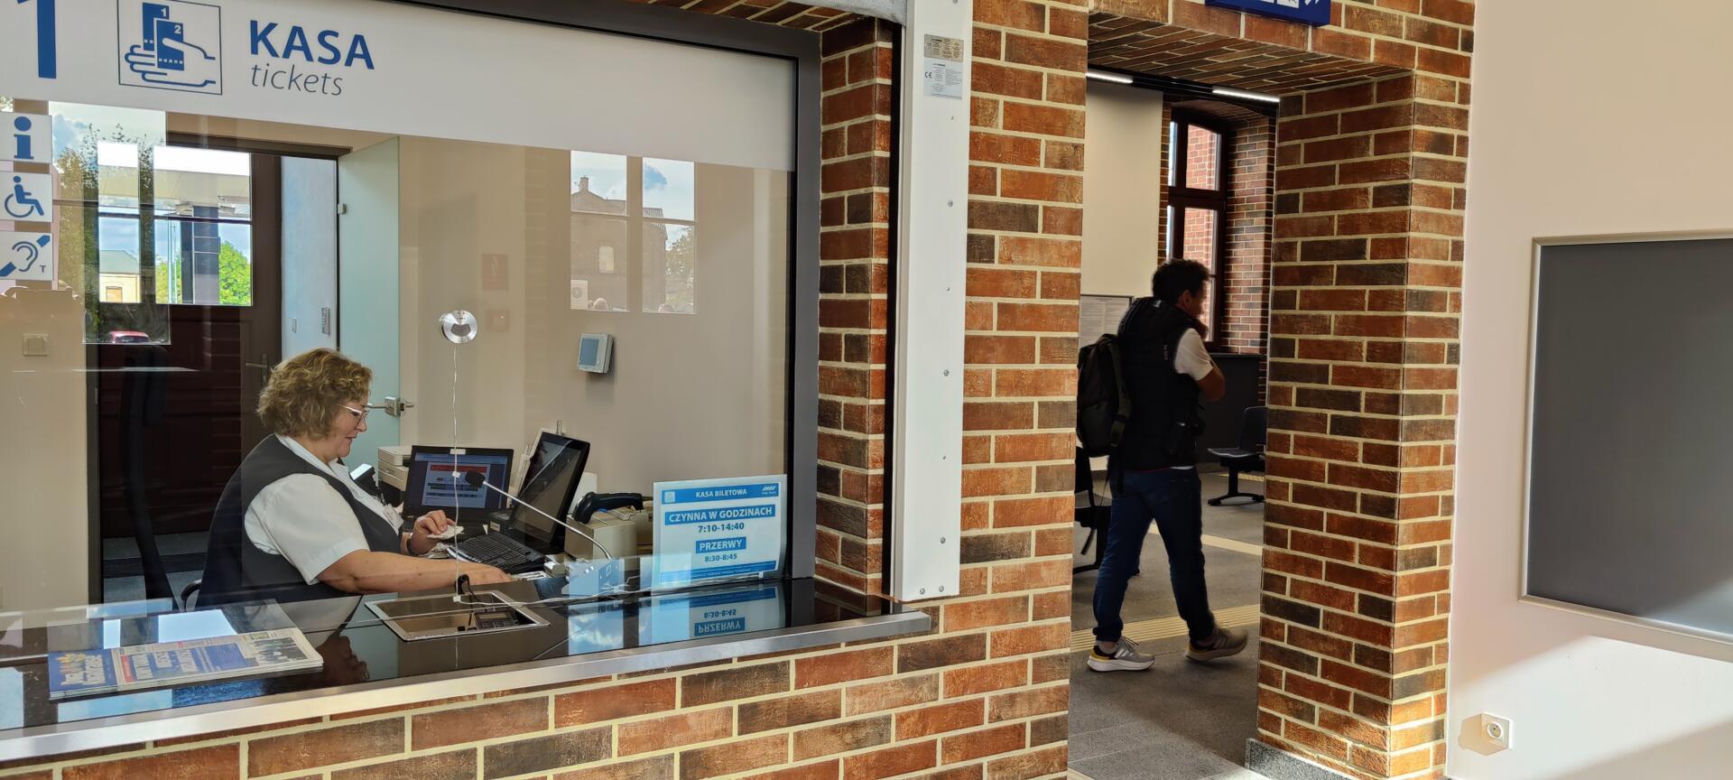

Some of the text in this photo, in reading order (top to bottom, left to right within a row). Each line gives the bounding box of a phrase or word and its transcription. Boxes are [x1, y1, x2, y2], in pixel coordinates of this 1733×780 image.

[160, 7, 168, 18] 1
[174, 24, 182, 34] 2
[16, 0, 57, 79] 1
[250, 19, 375, 70] KASA
[250, 63, 344, 96] tickets
[40, 264, 46, 273] T
[695, 488, 747, 498] KASA BILETOWA
[668, 506, 773, 523] CZYNNA W GODZINACH
[698, 522, 745, 533] 7:10-14:40
[699, 539, 743, 551] PRZERWY
